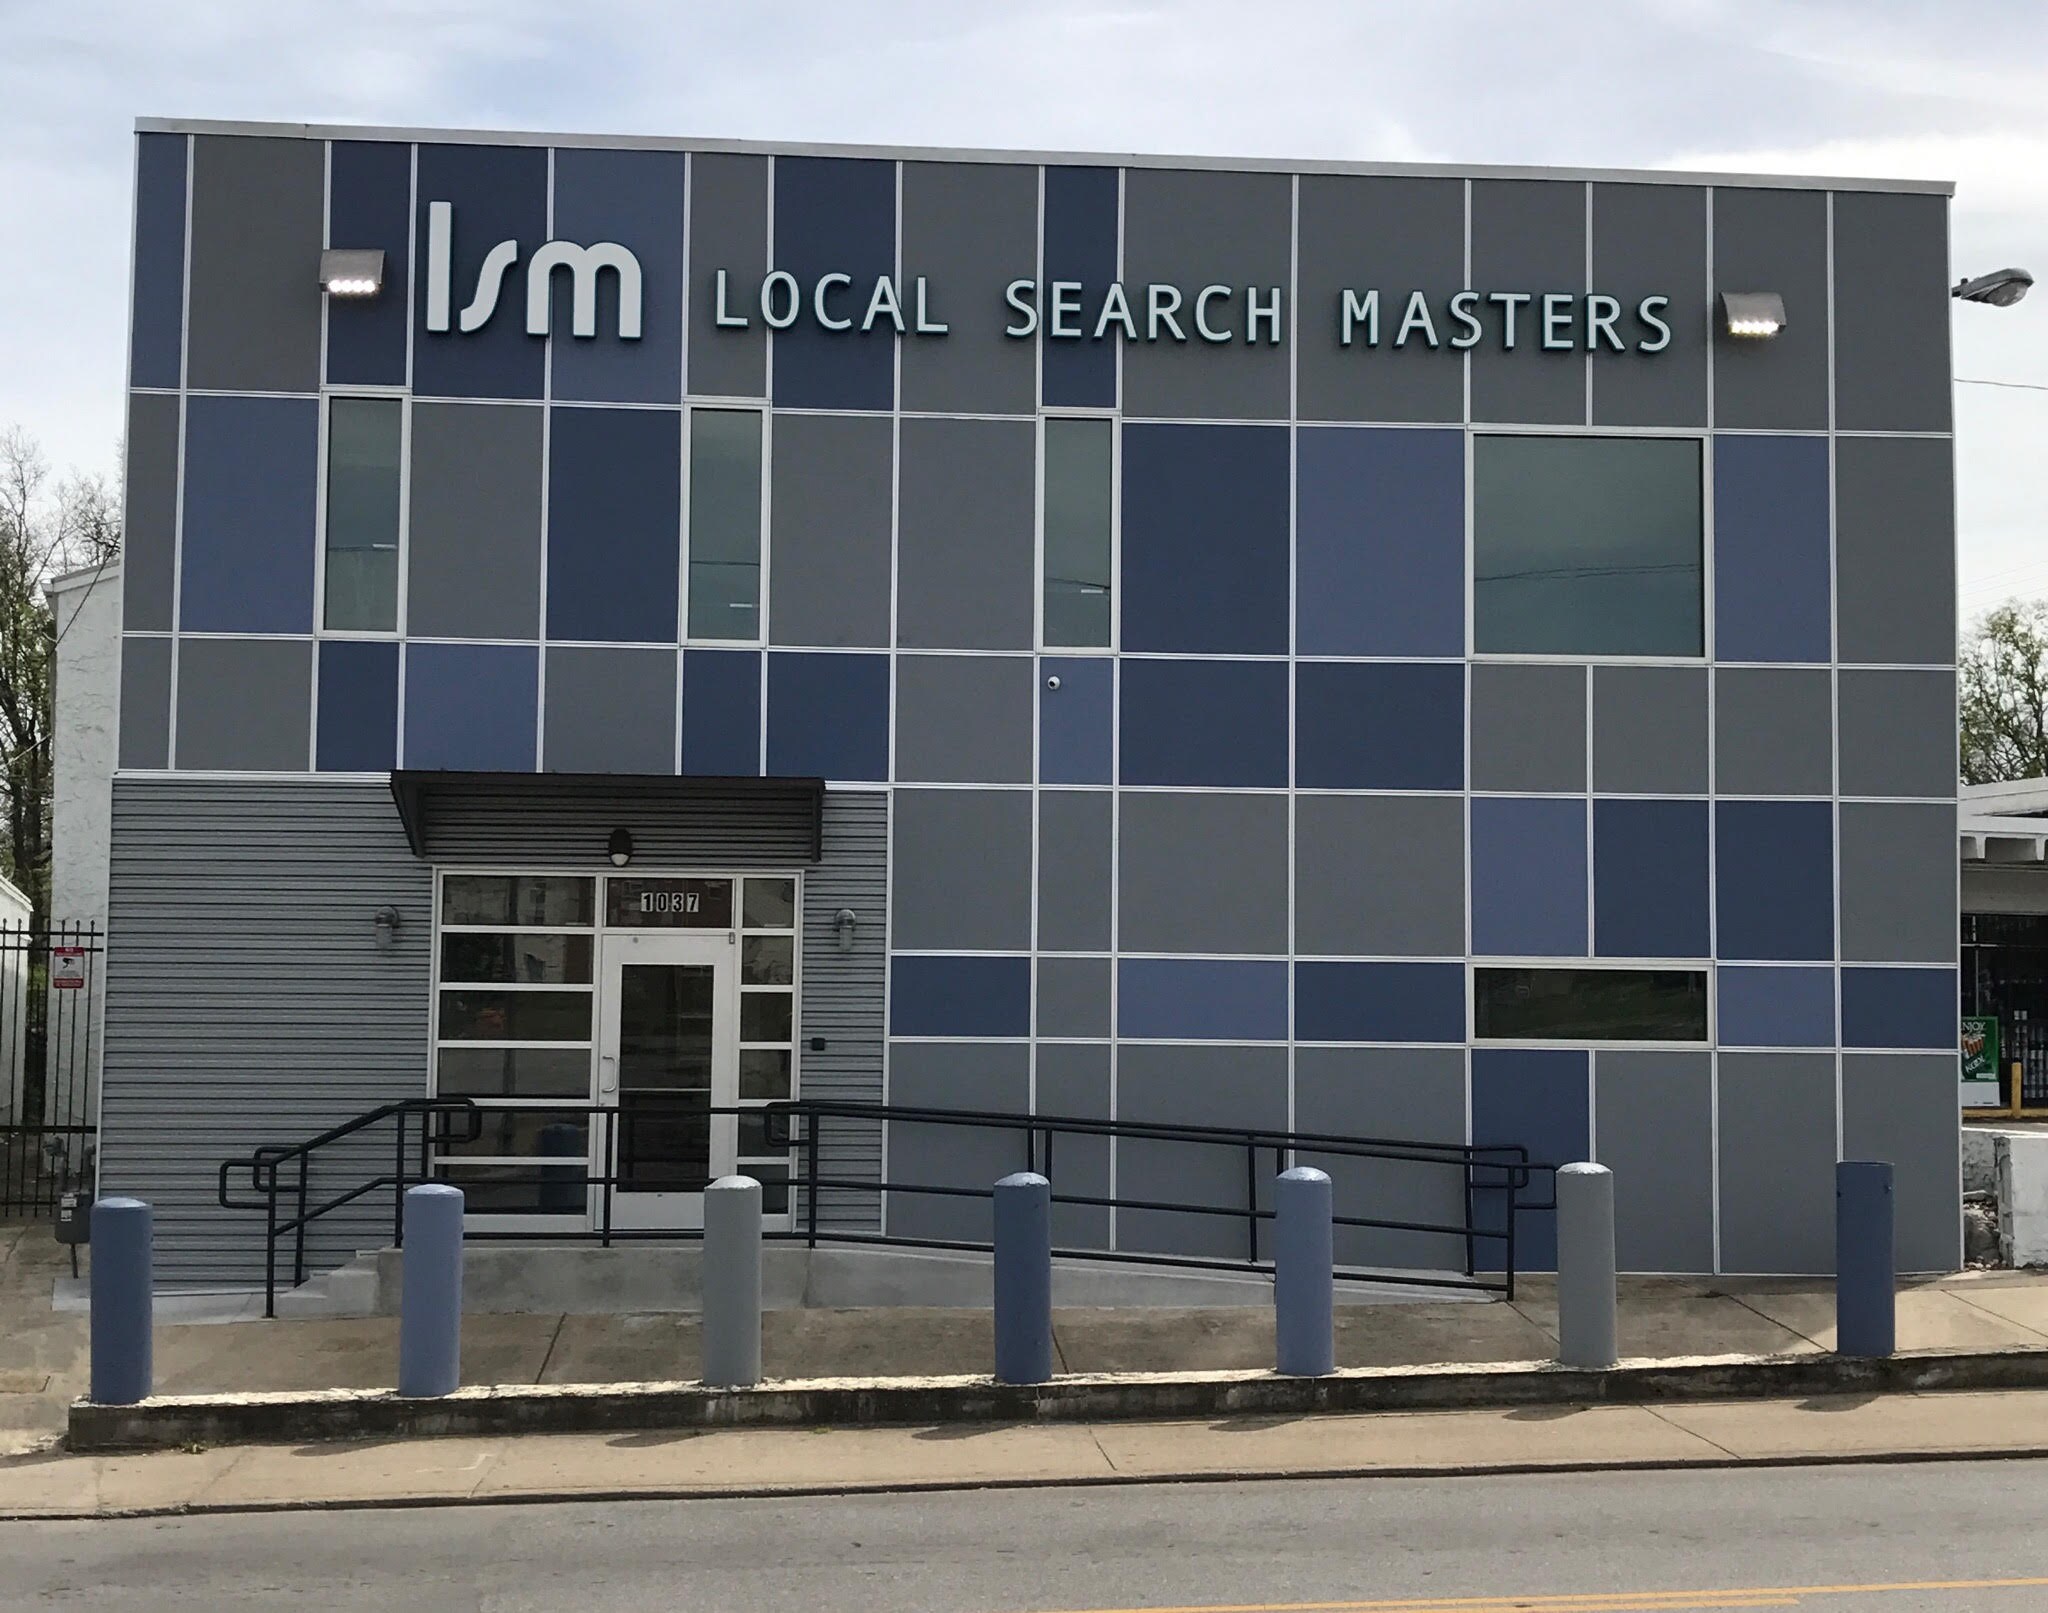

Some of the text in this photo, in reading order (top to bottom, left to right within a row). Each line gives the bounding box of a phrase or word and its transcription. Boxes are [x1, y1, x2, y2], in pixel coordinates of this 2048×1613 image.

[714, 269, 1672, 353] LOCAL SEARCH MASTERS
[641, 893, 699, 912] 1037
[1961, 1021, 1986, 1033] NJOY
